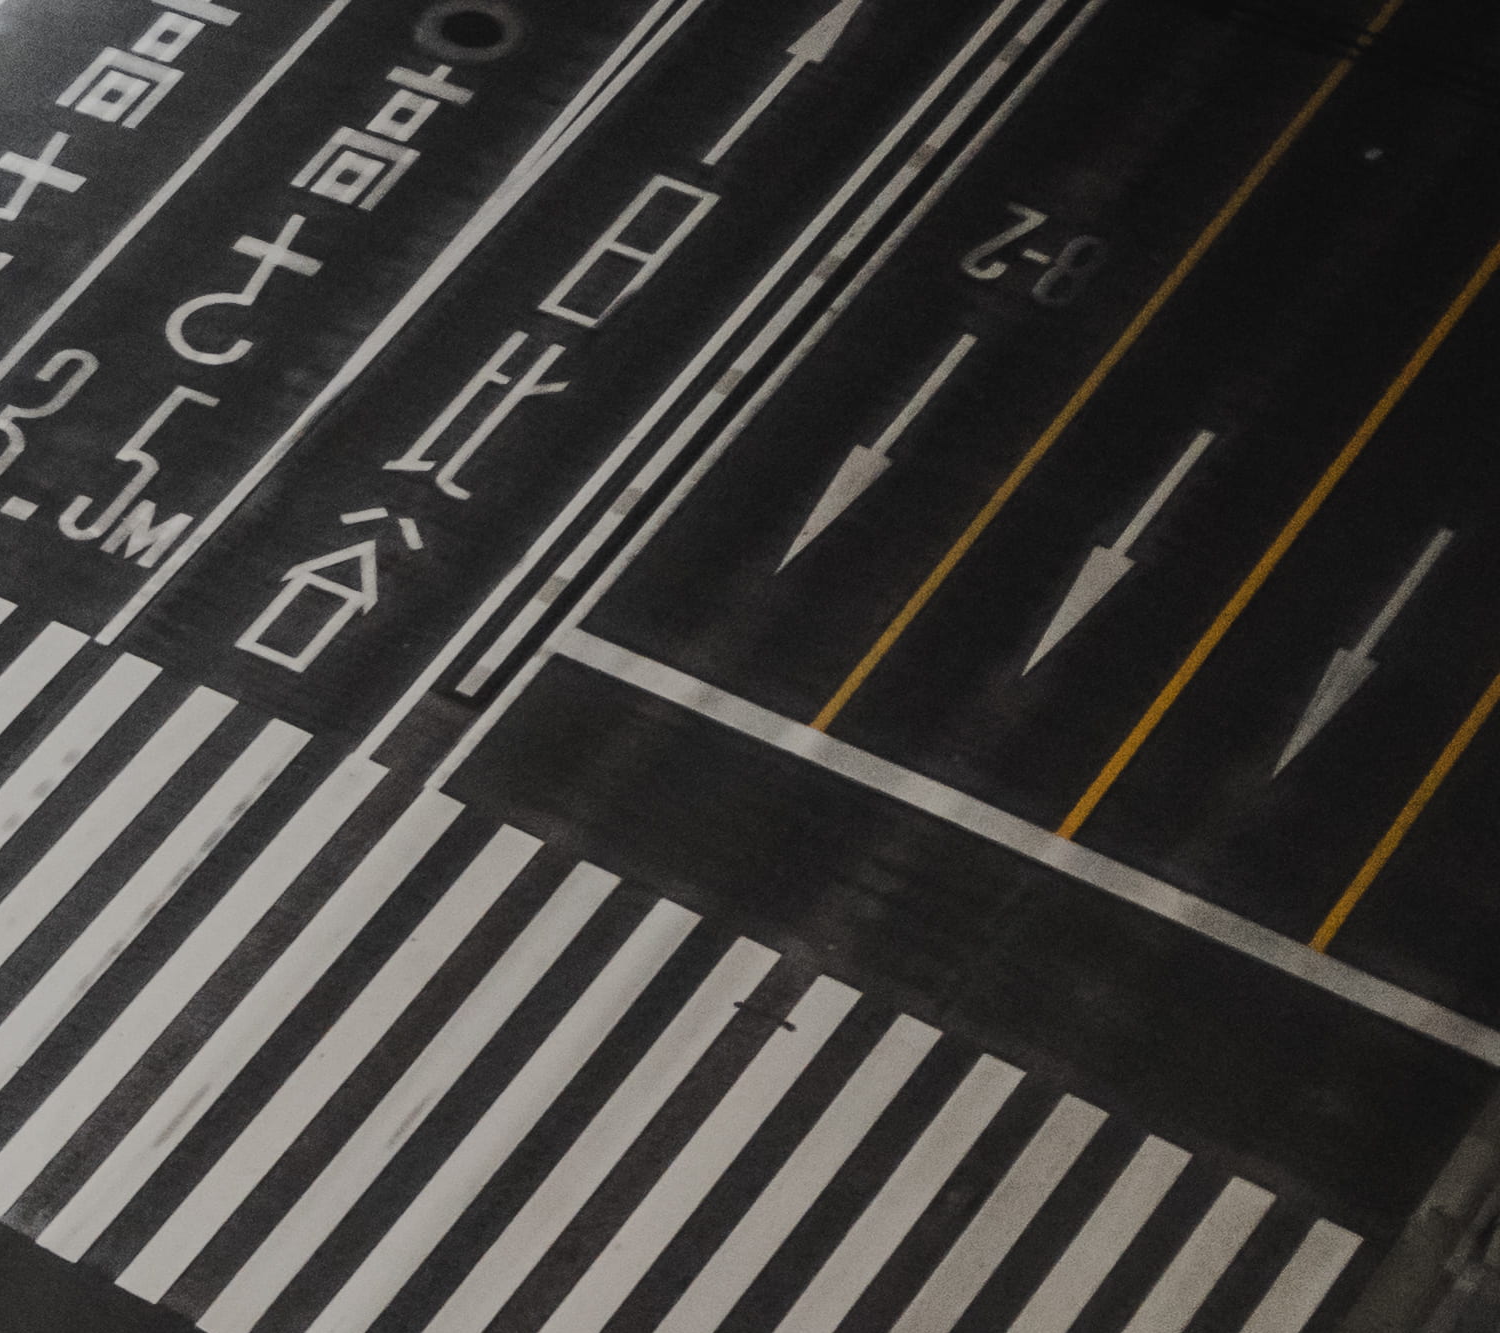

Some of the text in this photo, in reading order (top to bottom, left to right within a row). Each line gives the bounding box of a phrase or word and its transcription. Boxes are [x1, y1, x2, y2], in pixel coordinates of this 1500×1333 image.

[164, 63, 476, 366] 高さ
[235, 173, 720, 673] 日比谷
